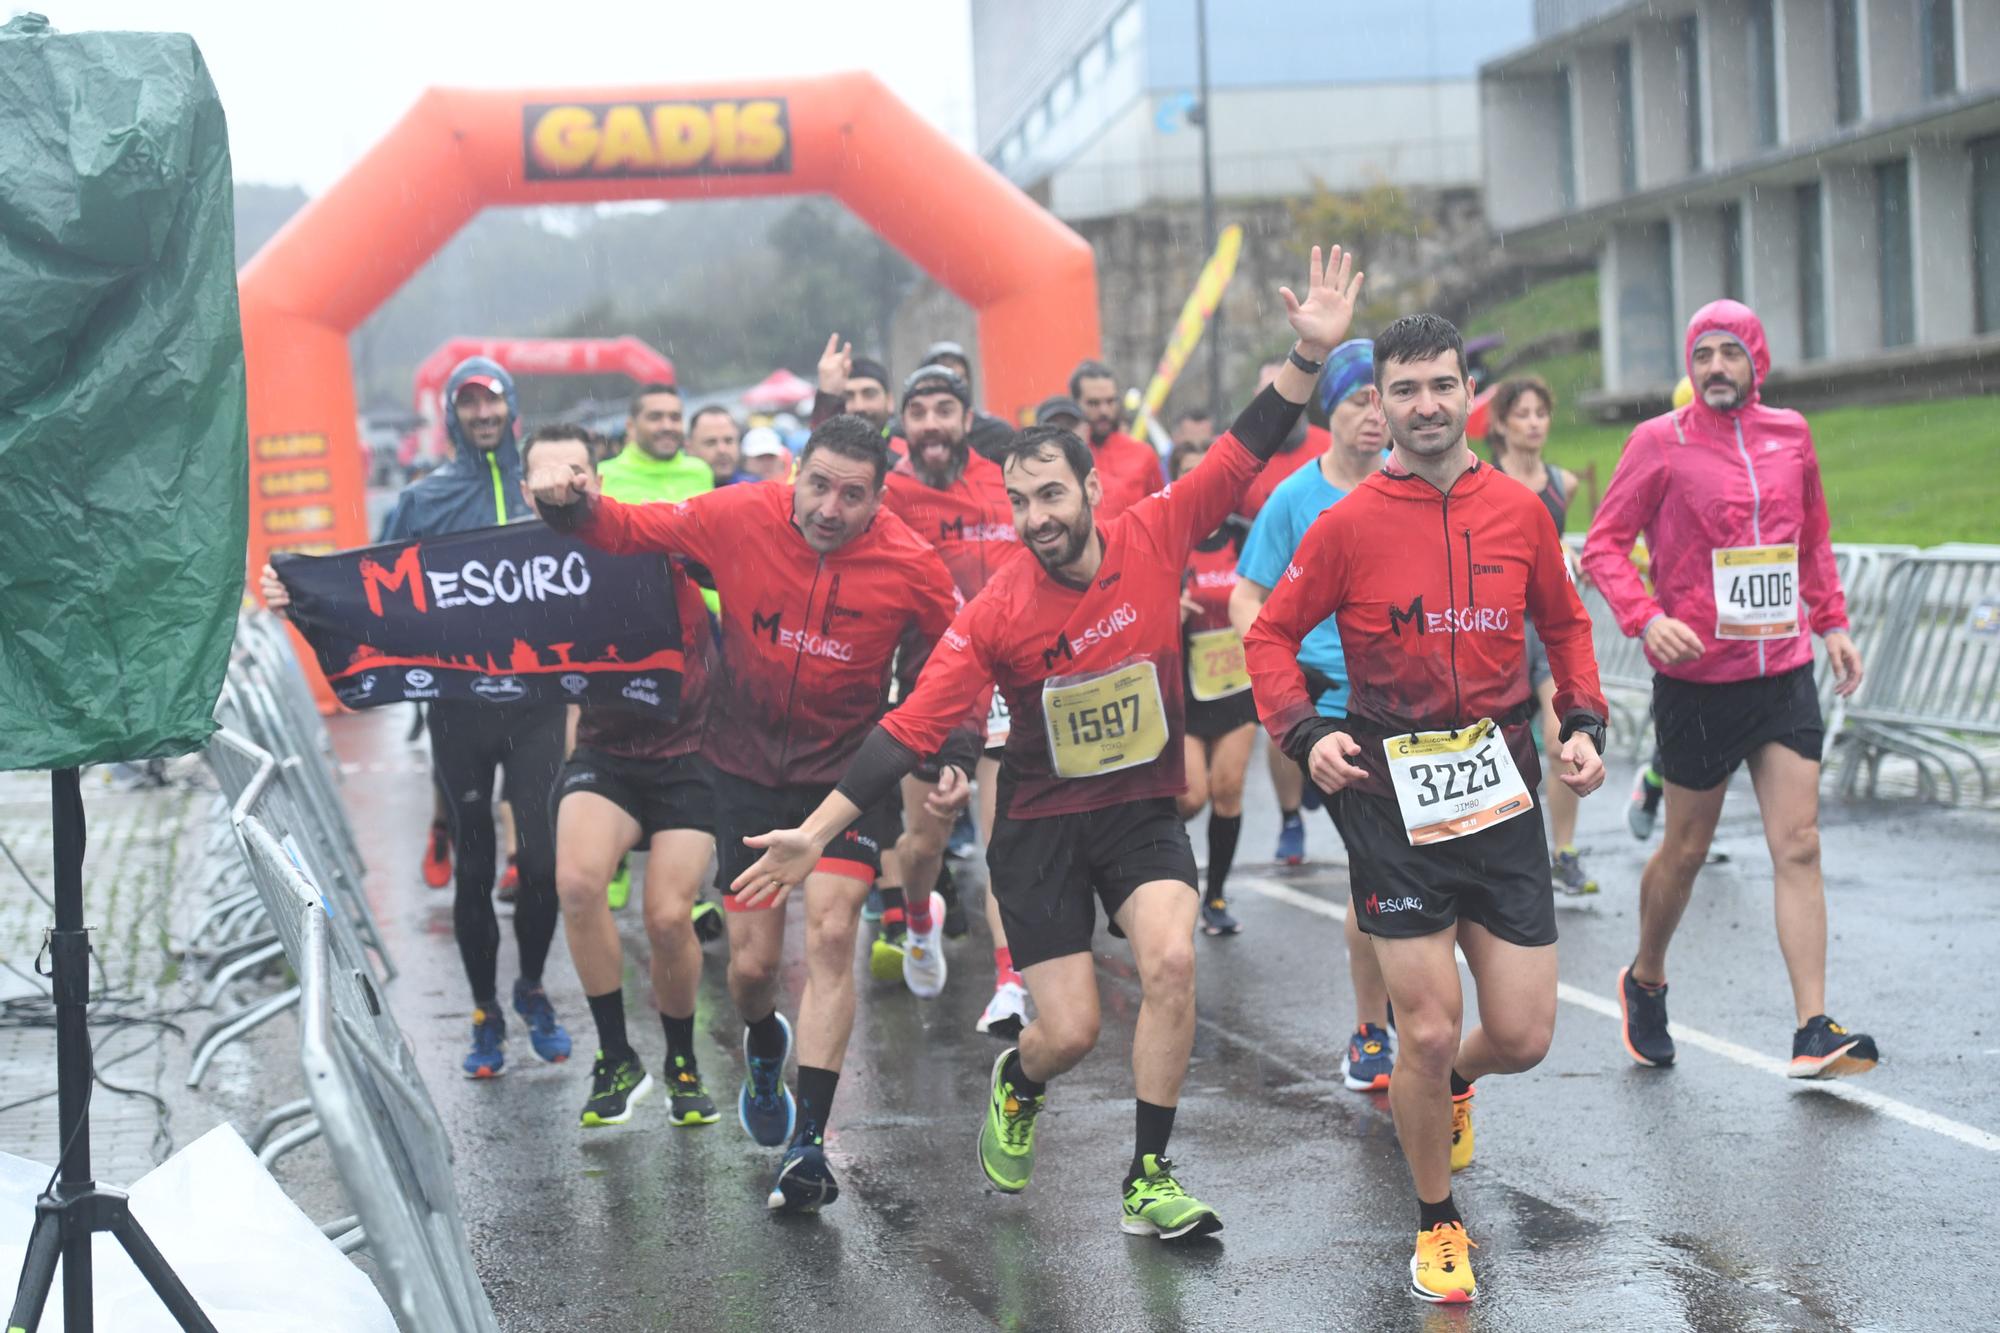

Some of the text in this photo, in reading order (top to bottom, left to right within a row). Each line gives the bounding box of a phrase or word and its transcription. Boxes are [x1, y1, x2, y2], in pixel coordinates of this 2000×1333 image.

[532, 100, 785, 173] GADIS
[1729, 572, 1792, 608] 4006
[1068, 693, 1139, 745] 1597
[1409, 744, 1501, 807] 3225
[1455, 799, 1480, 813] JIMBO
